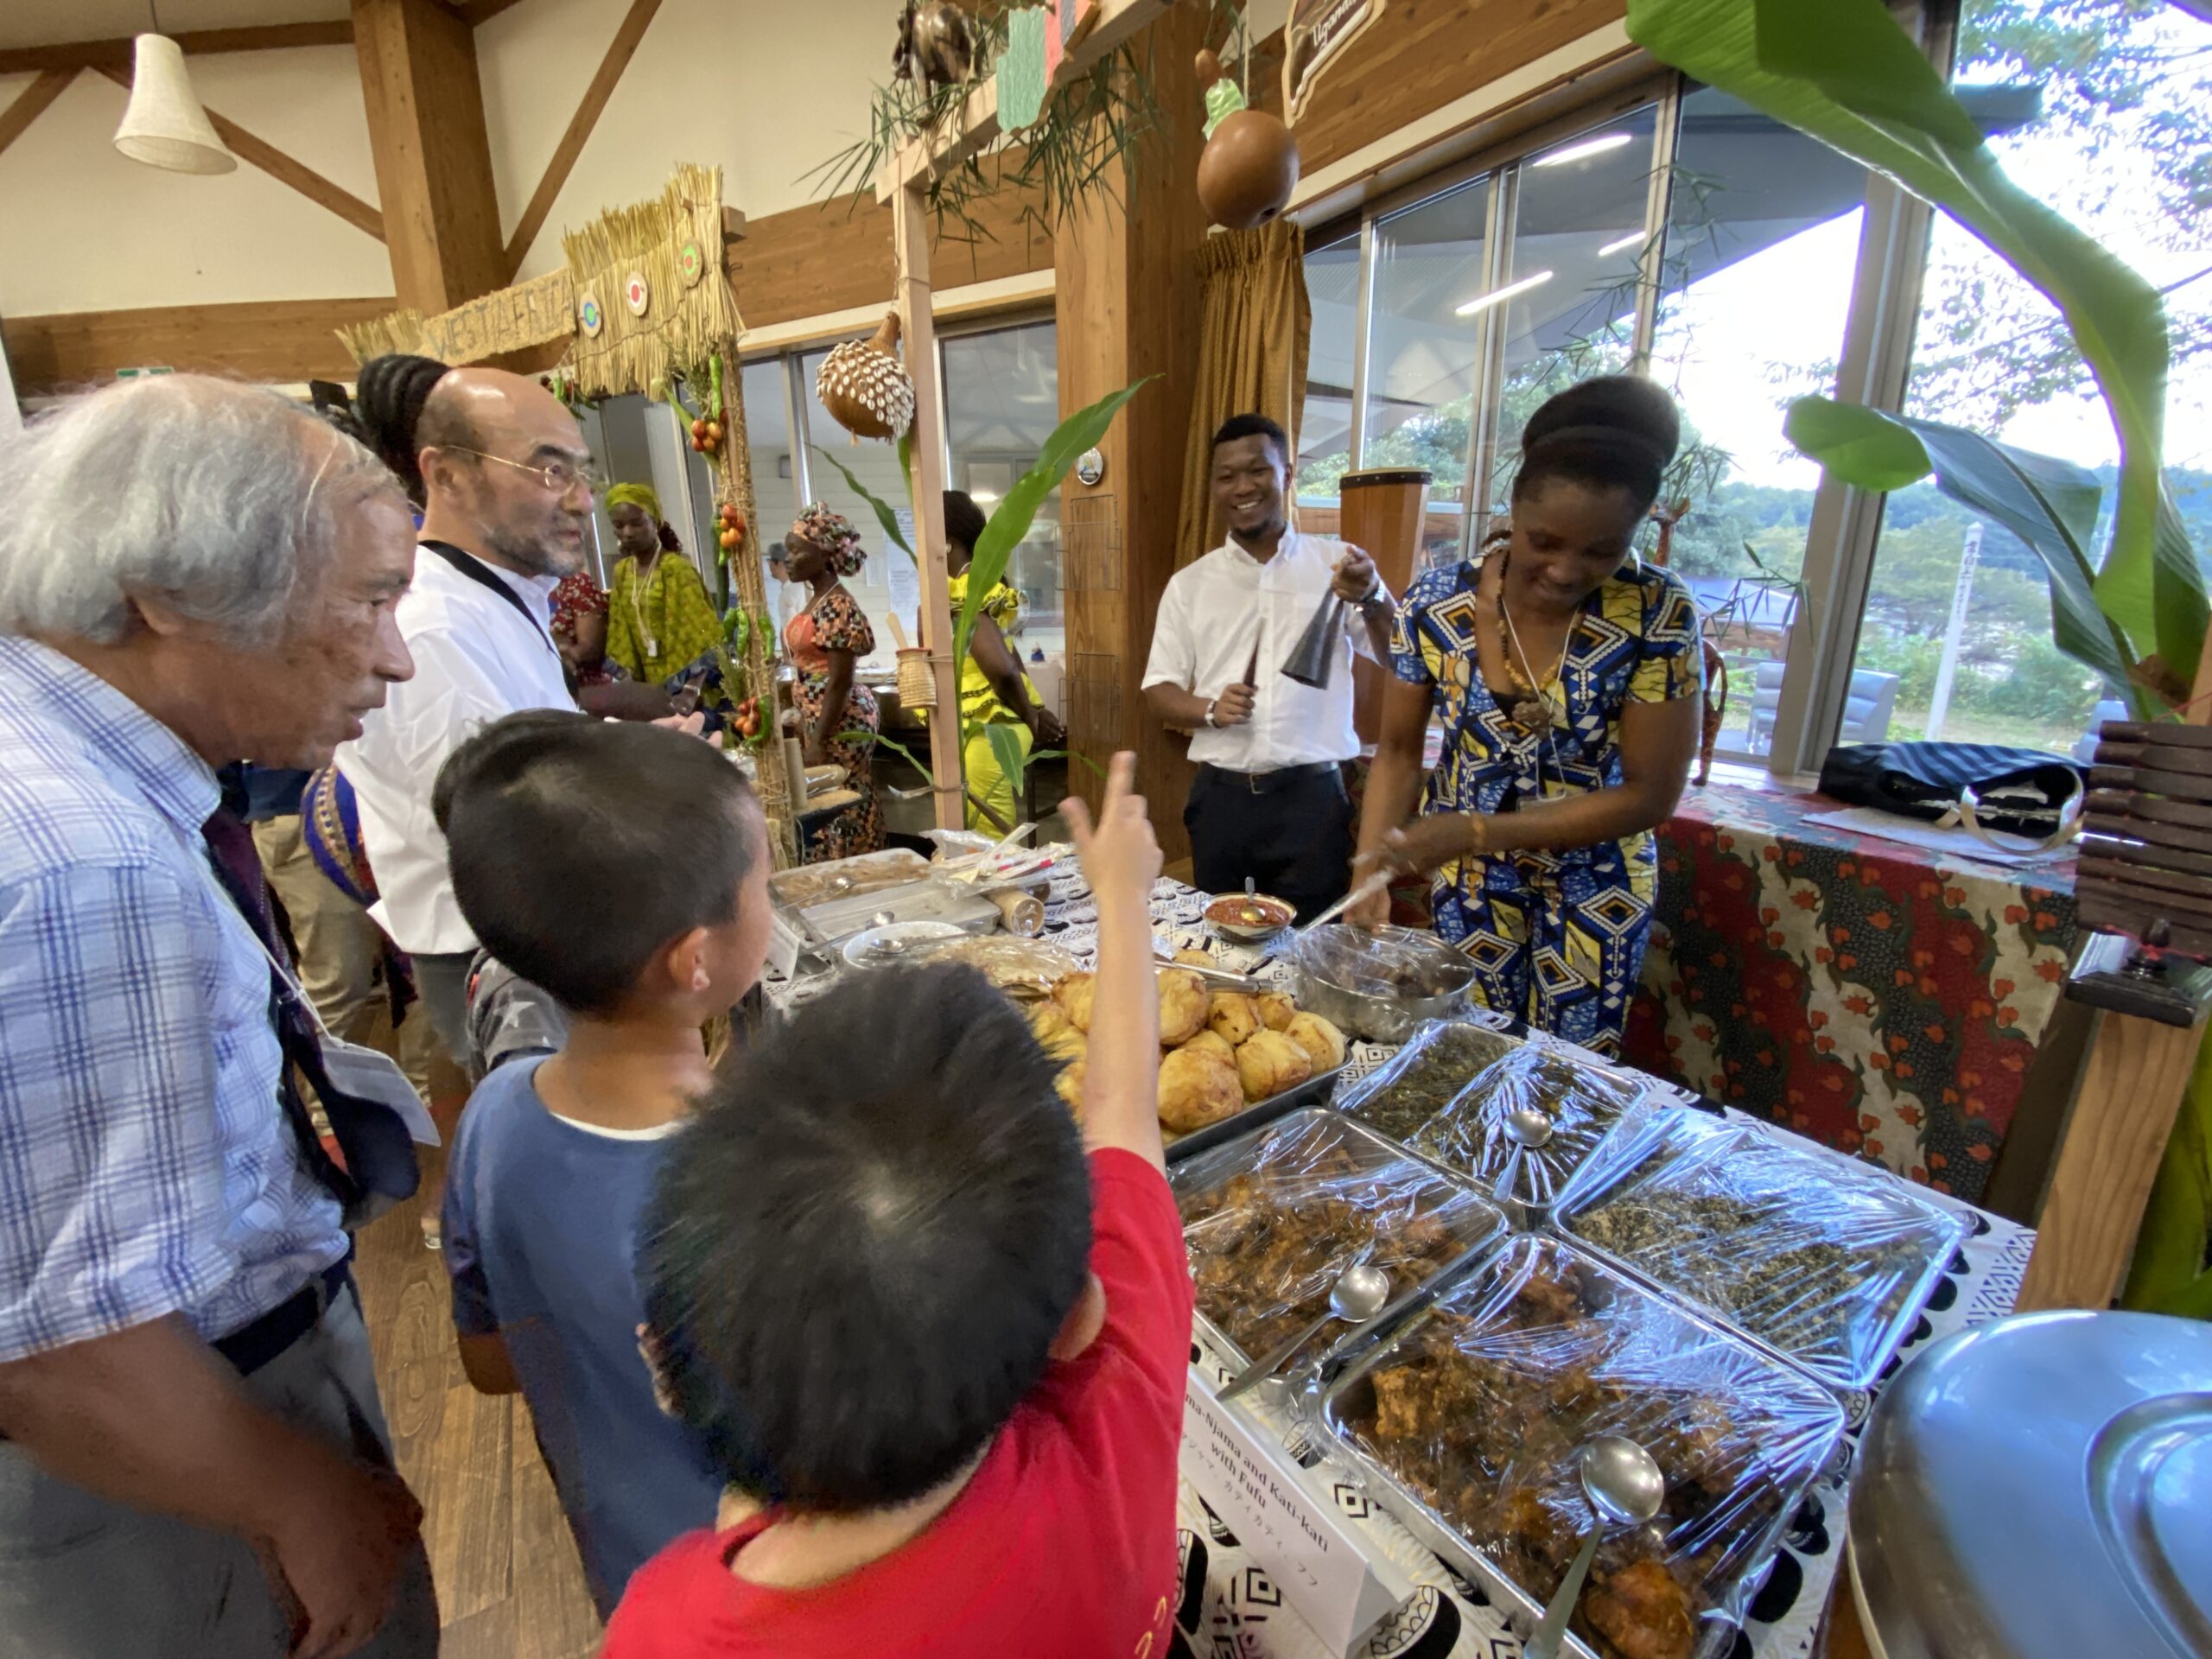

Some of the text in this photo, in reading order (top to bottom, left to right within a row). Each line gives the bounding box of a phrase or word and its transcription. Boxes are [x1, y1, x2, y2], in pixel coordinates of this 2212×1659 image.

[1211, 1441, 1267, 1509] with Fufu
[1243, 1456, 1268, 1486] and
[1269, 1482, 1329, 1554] Kati-kati
